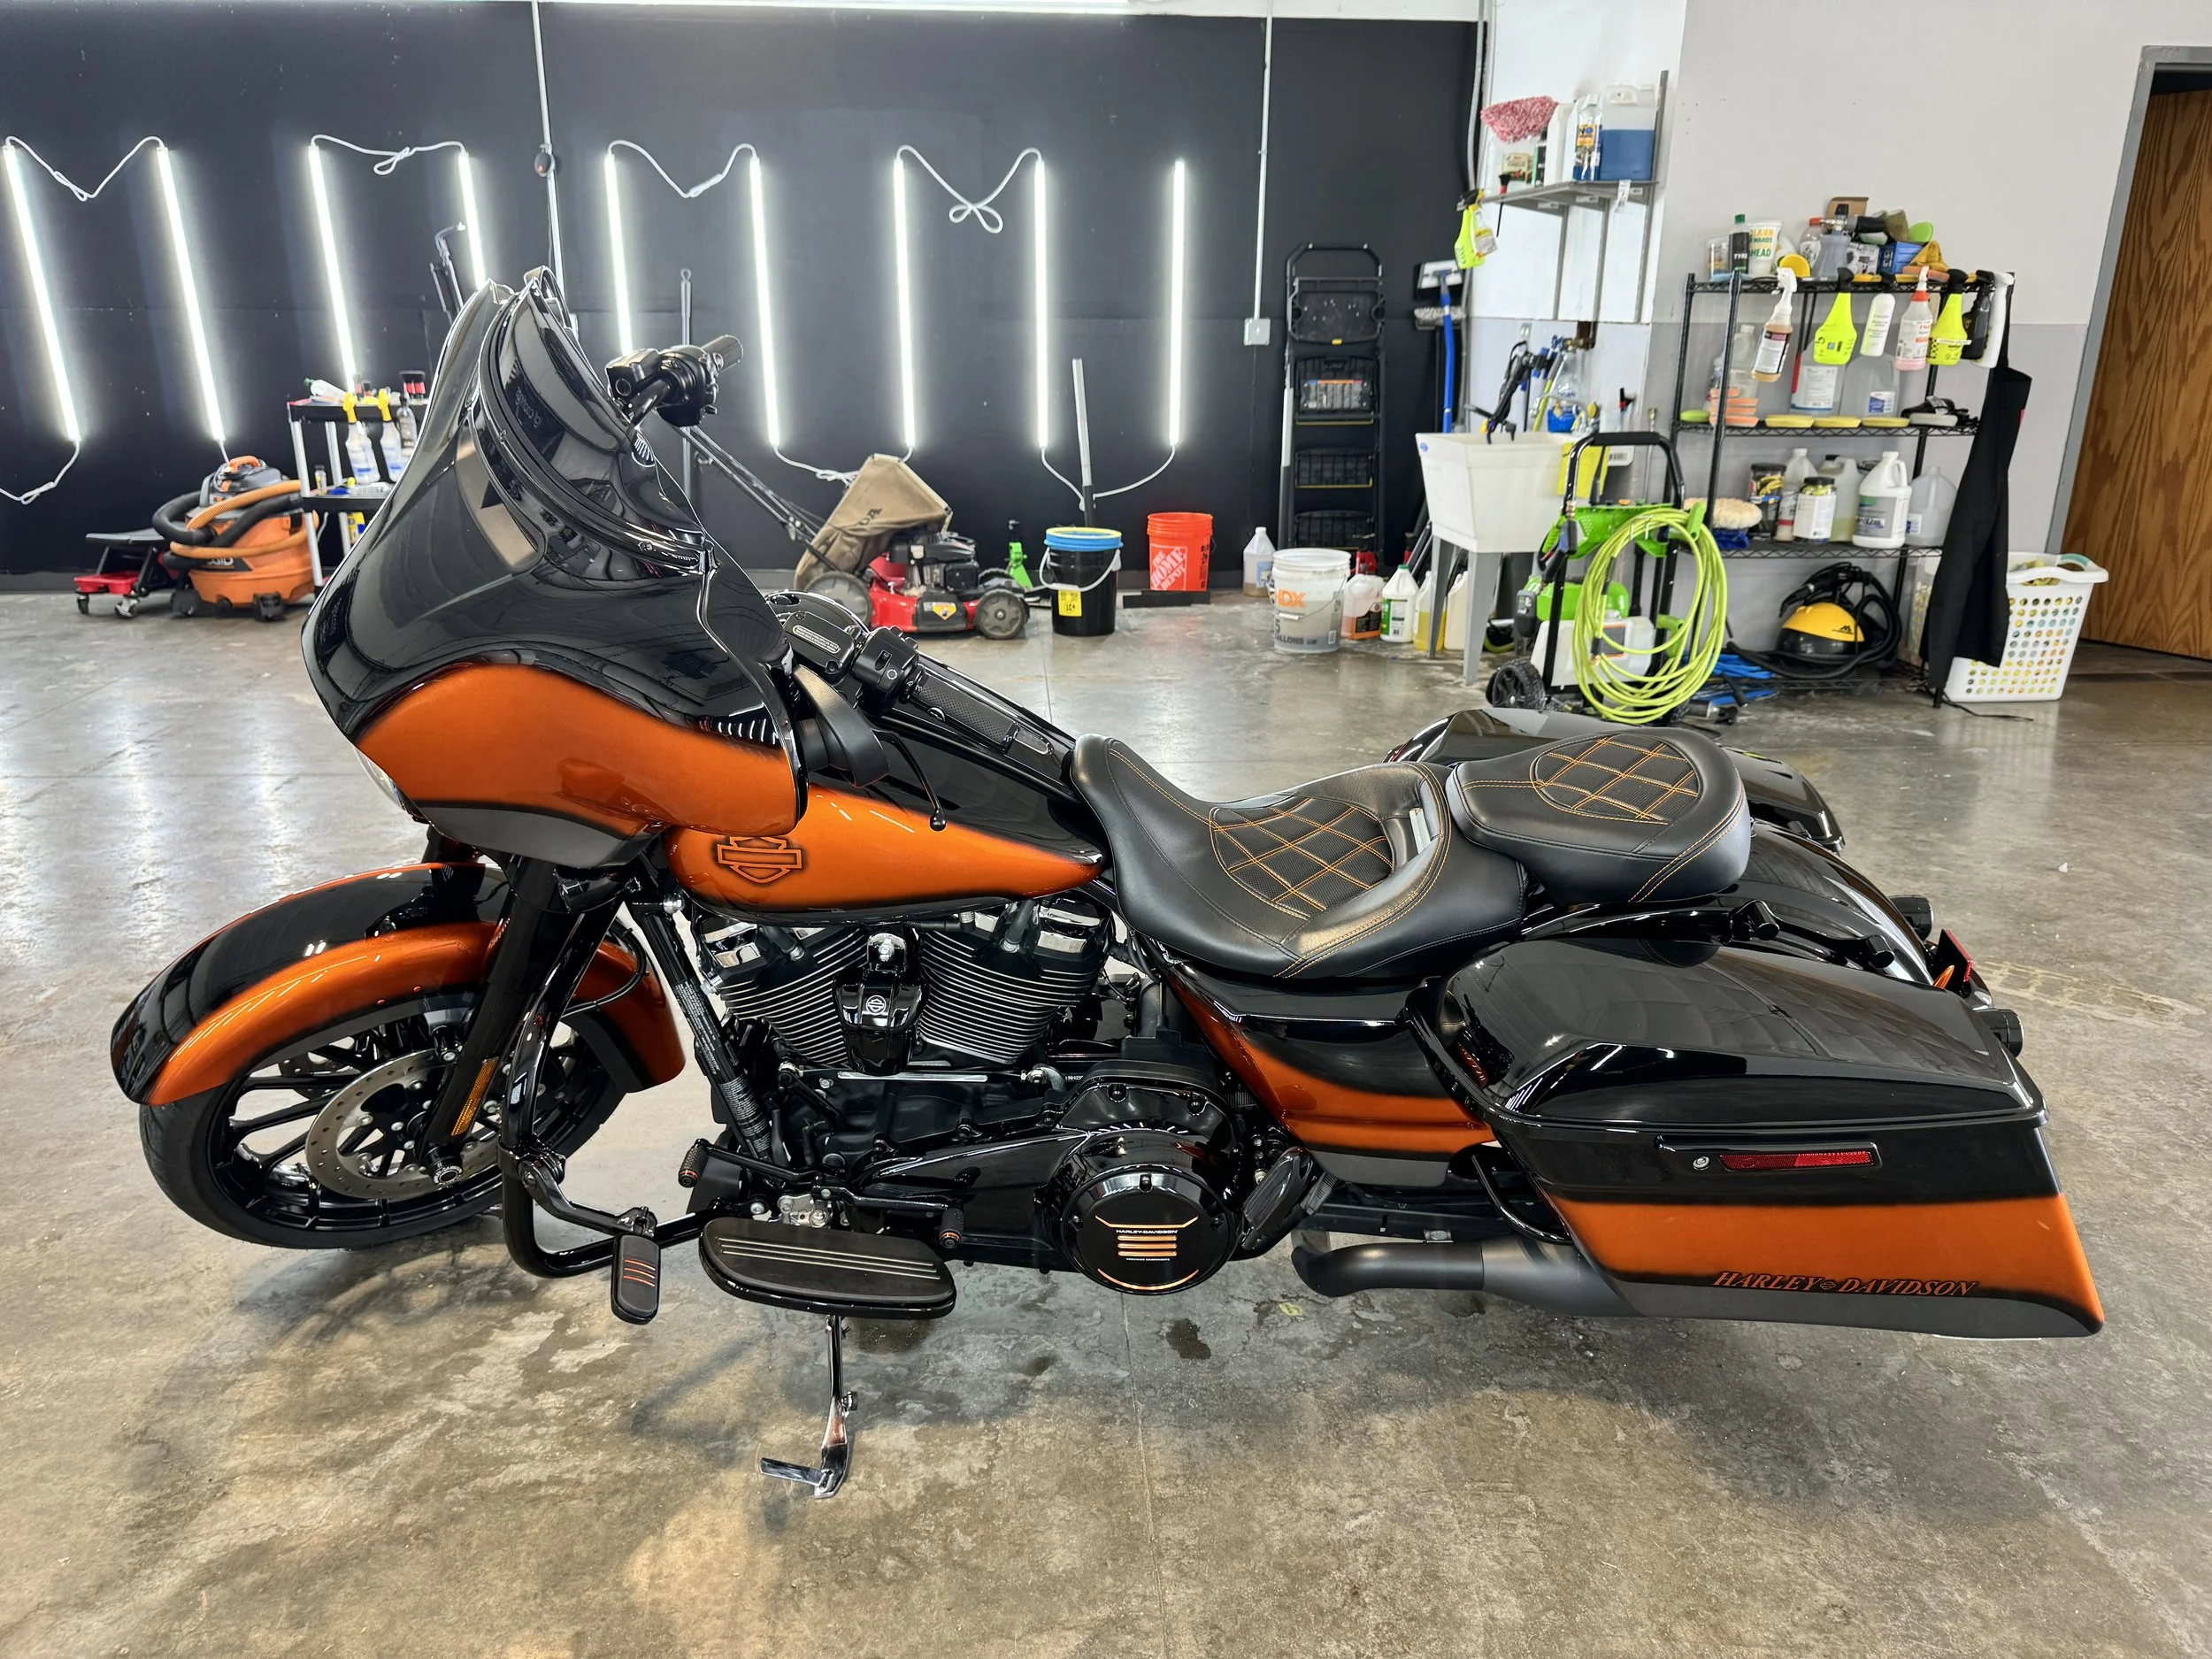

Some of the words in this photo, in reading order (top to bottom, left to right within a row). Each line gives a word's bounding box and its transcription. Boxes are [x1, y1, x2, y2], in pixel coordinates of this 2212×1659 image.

[1150, 547, 1187, 589] HOME
[1160, 564, 1186, 591] DEPOT
[1713, 1271, 1826, 1292] HARLEY
[1838, 1279, 1978, 1297] DAVIDSON
